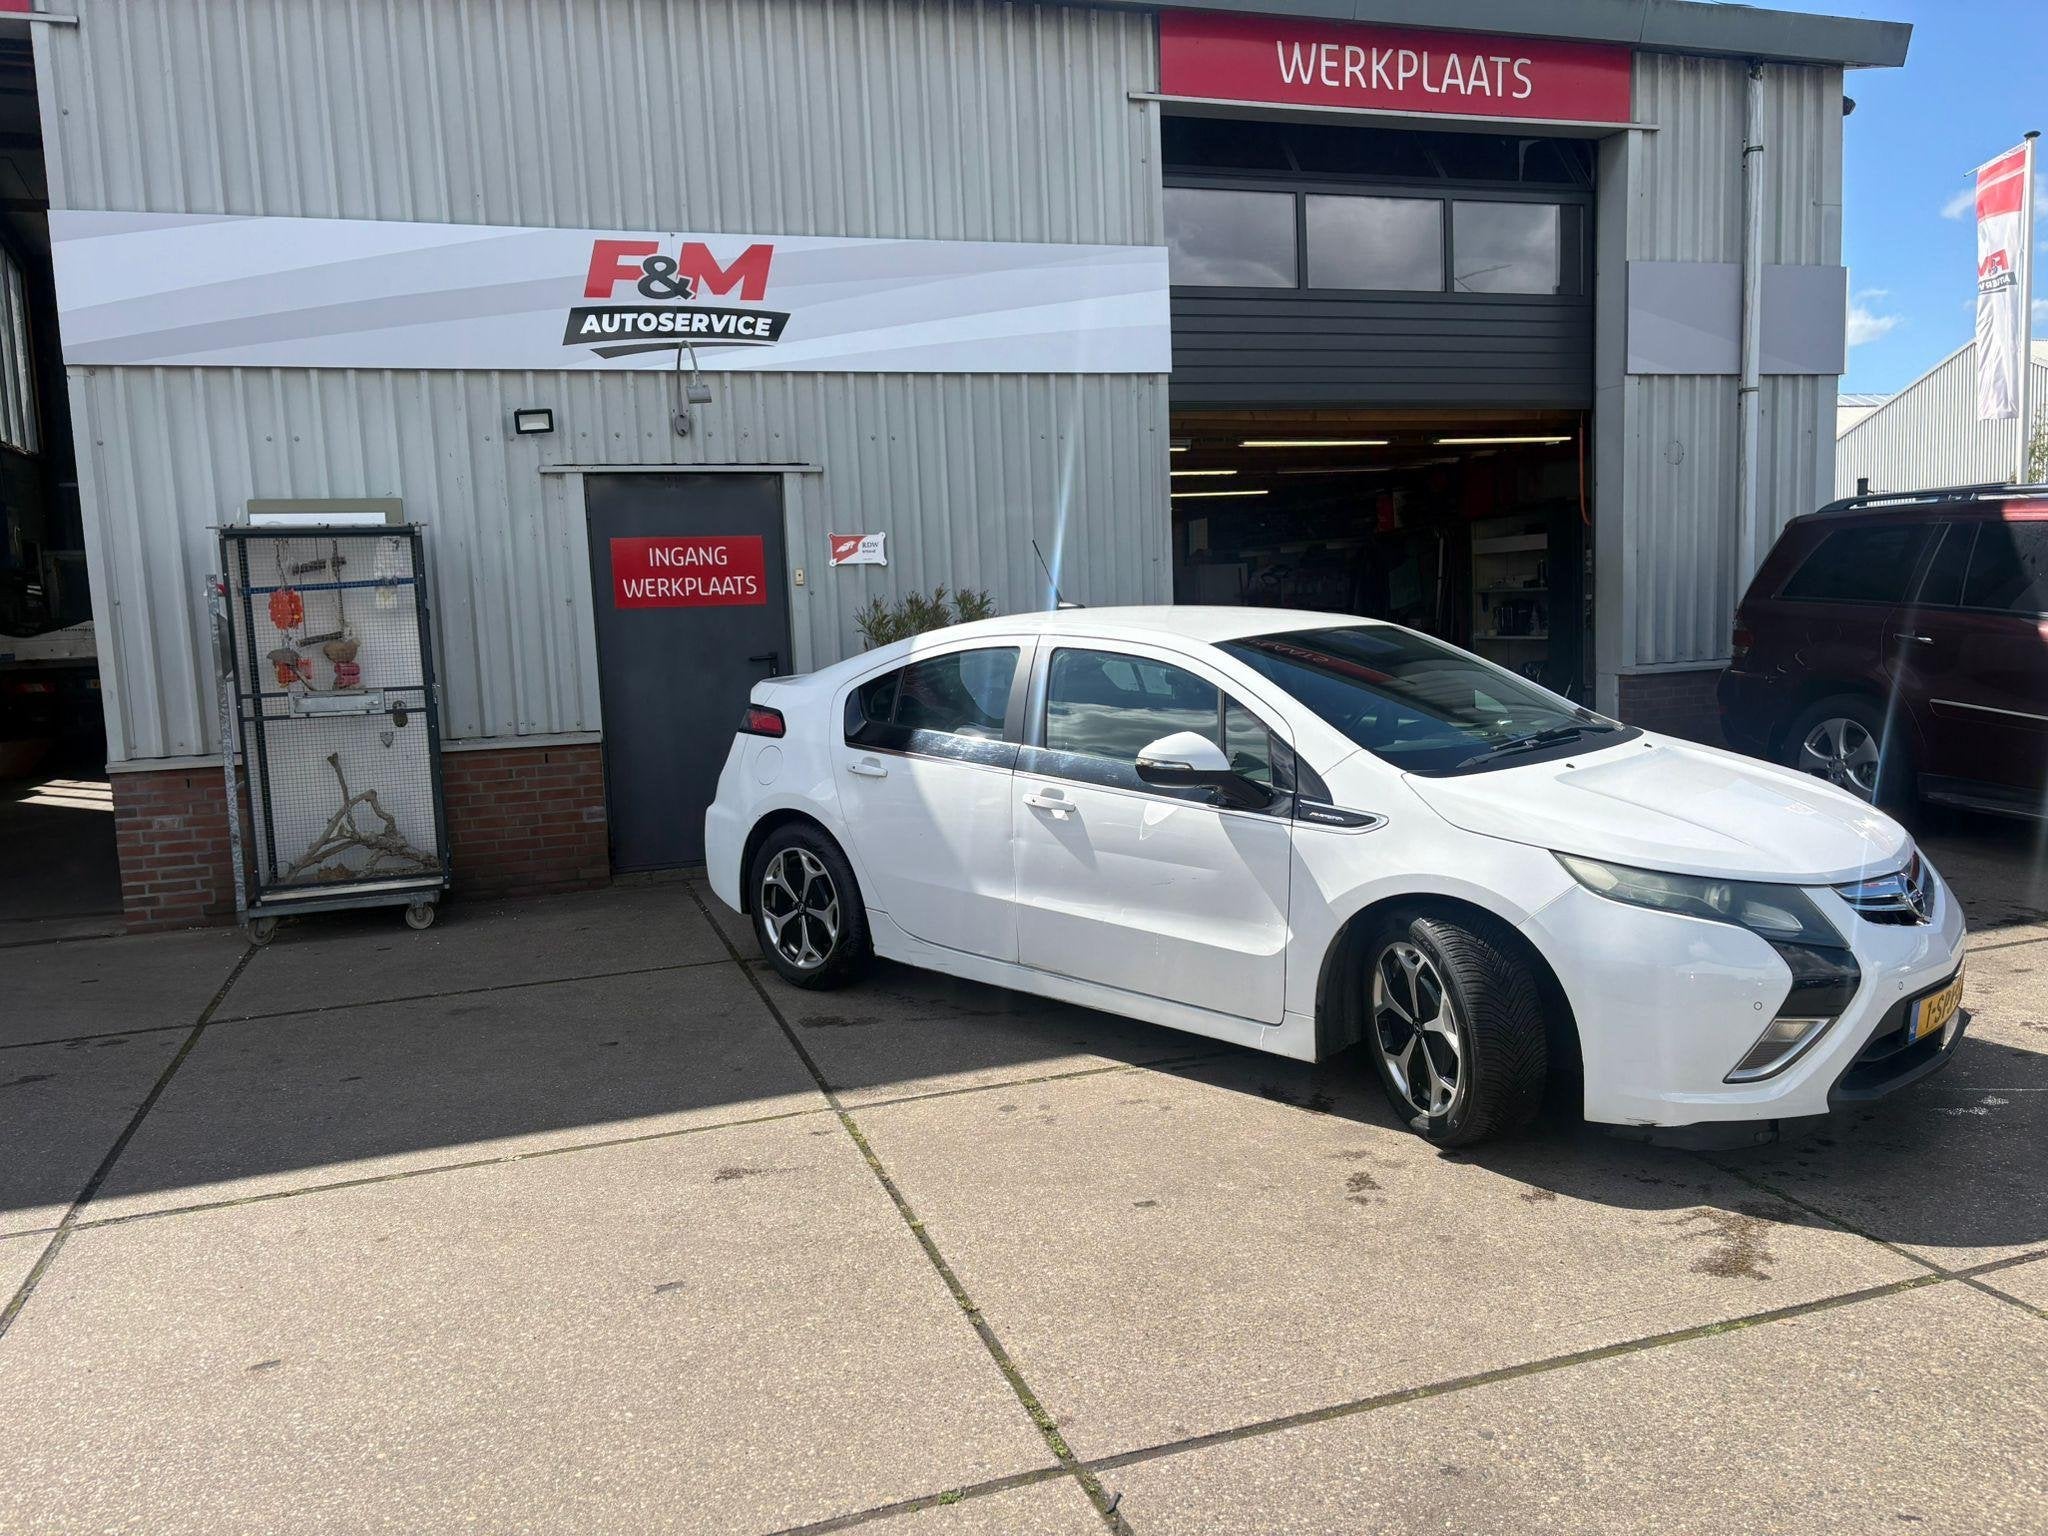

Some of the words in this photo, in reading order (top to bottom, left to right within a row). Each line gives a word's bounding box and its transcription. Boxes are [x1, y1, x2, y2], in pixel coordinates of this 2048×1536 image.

[1276, 40, 1532, 99] WERKPLAATS
[584, 239, 774, 301] F&M
[580, 313, 773, 336] AUTOSERVICE
[649, 546, 728, 567] INGANG
[623, 575, 757, 598] WERKPLAATS
